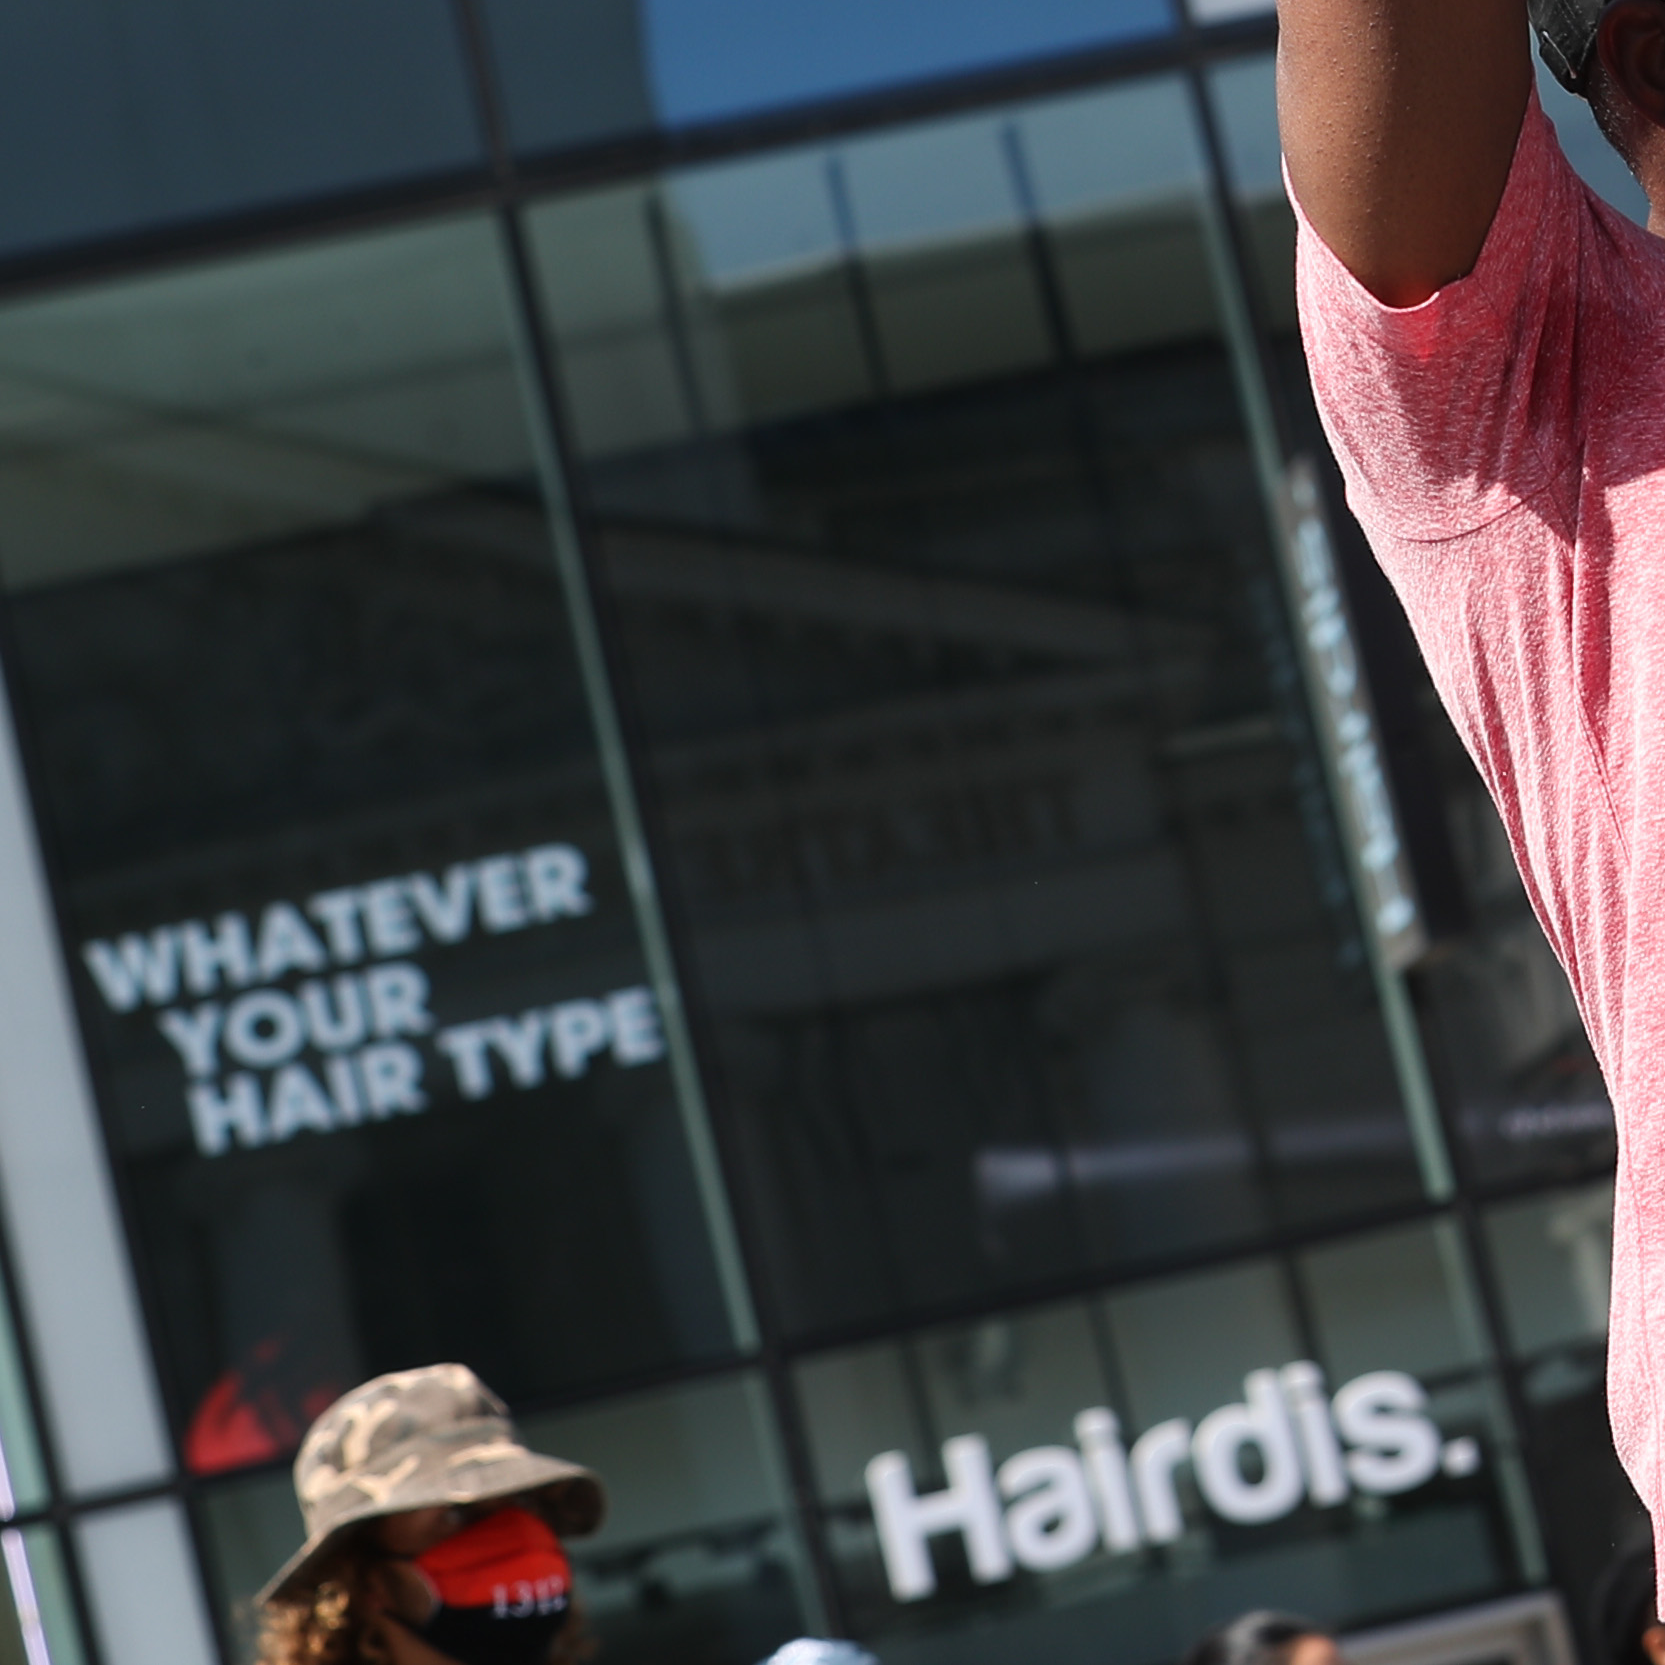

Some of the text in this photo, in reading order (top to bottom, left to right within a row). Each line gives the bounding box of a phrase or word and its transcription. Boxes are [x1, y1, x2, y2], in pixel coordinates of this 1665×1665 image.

[83, 841, 592, 1012] WHATEVER
[157, 962, 434, 1076] YOUR
[186, 986, 667, 1156] HAIR TYPE
[865, 1360, 1480, 1602] Hairdis.
